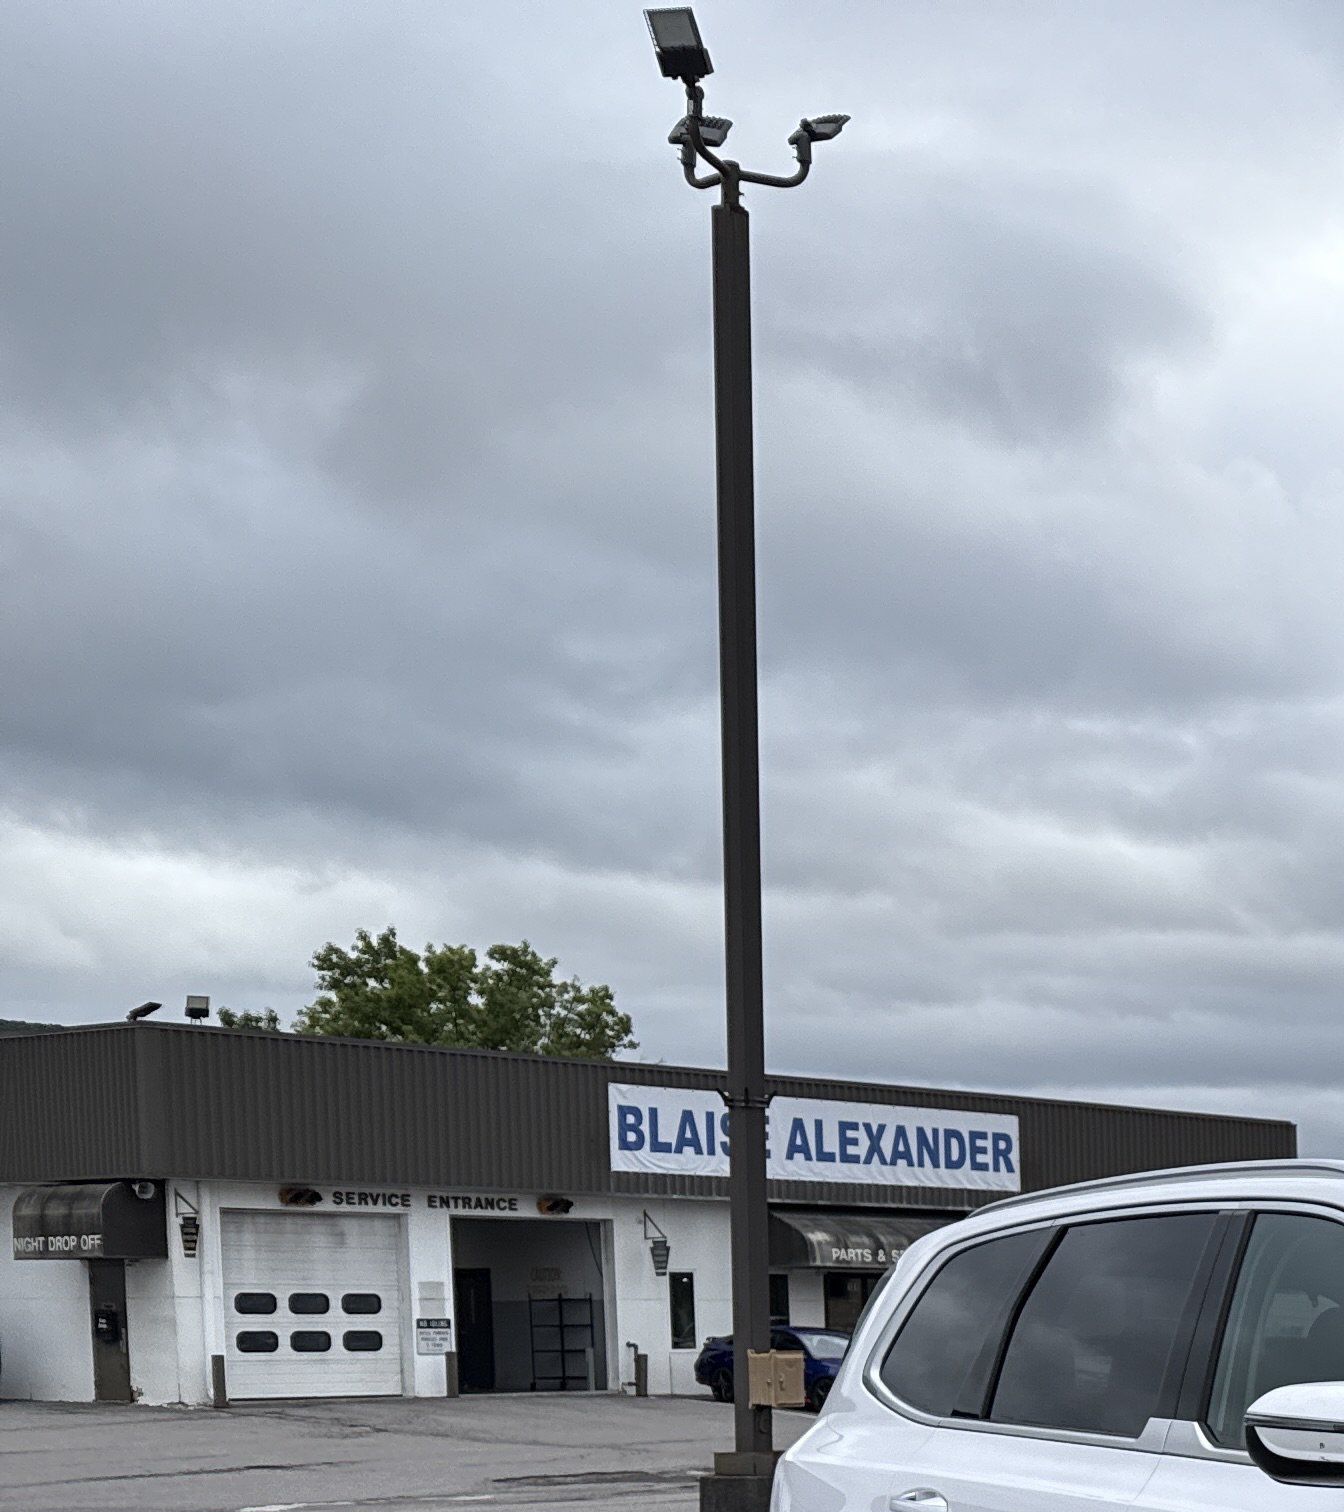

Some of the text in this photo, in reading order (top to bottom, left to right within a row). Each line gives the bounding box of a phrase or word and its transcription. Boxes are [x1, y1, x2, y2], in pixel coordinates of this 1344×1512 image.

[616, 1104, 1016, 1173] BLAI ALEXANDER
[333, 1191, 518, 1211] SERVICE ENTRANCE
[13, 1234, 102, 1252] NIGHT DROP OFF
[831, 1248, 873, 1263] PARTS
[877, 1250, 886, 1262] &
